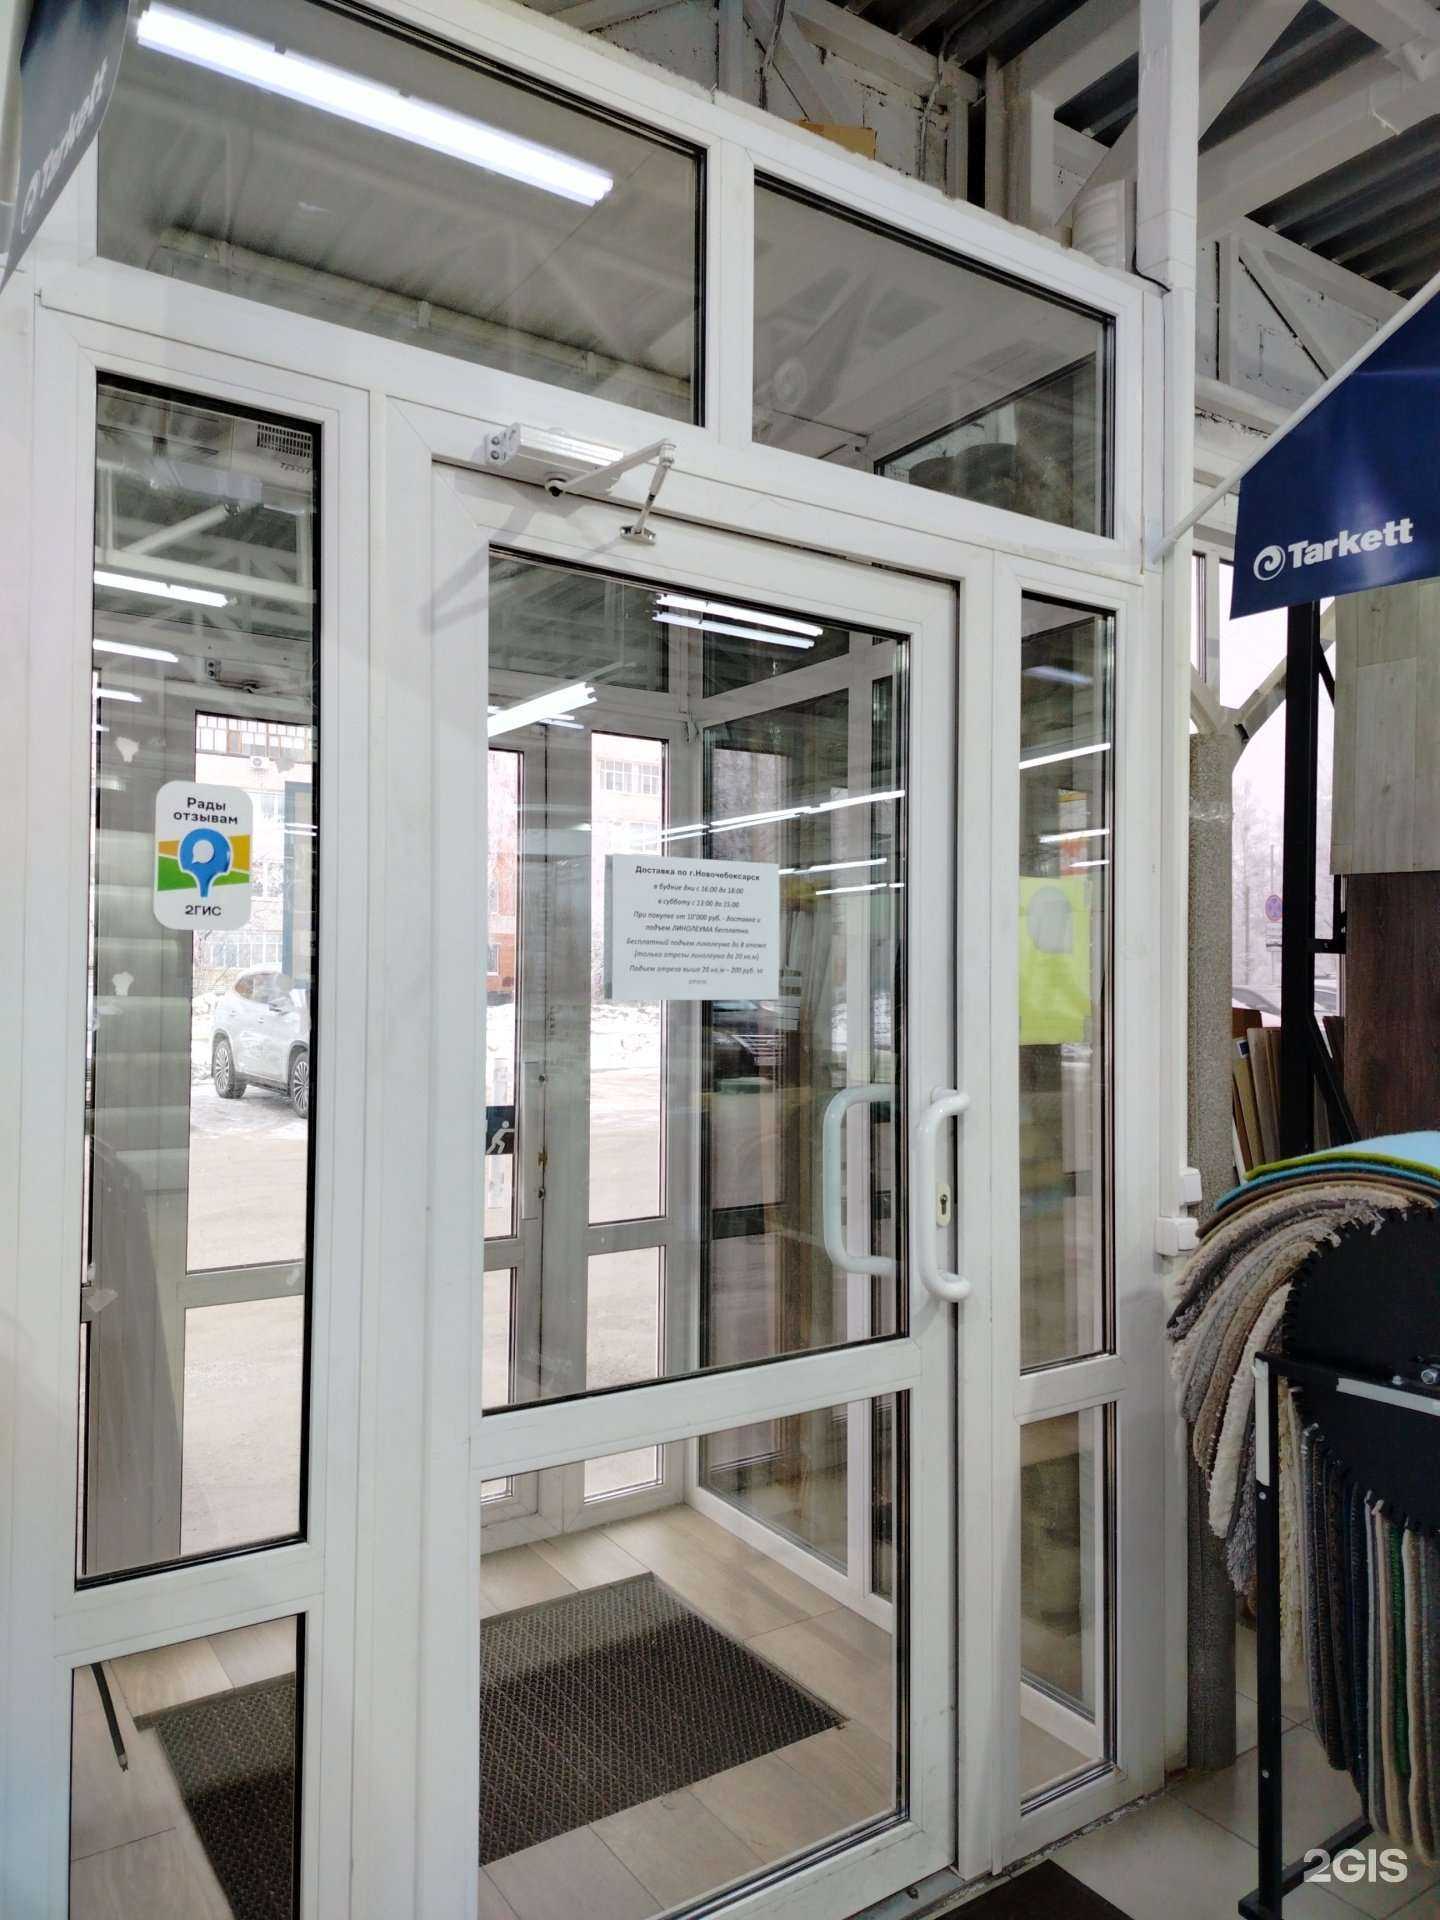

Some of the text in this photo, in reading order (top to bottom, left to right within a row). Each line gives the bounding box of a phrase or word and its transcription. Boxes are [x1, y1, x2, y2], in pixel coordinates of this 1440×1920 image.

[1287, 517, 1414, 569] Tarkett
[187, 797, 226, 811] Рады
[173, 811, 239, 824] отзывам
[636, 866, 675, 875] Доставка
[664, 898, 690, 906] субботу
[185, 904, 222, 917] 2ГИС
[633, 911, 647, 919] При
[672, 925, 713, 933] ЛИНОЛЕУМА
